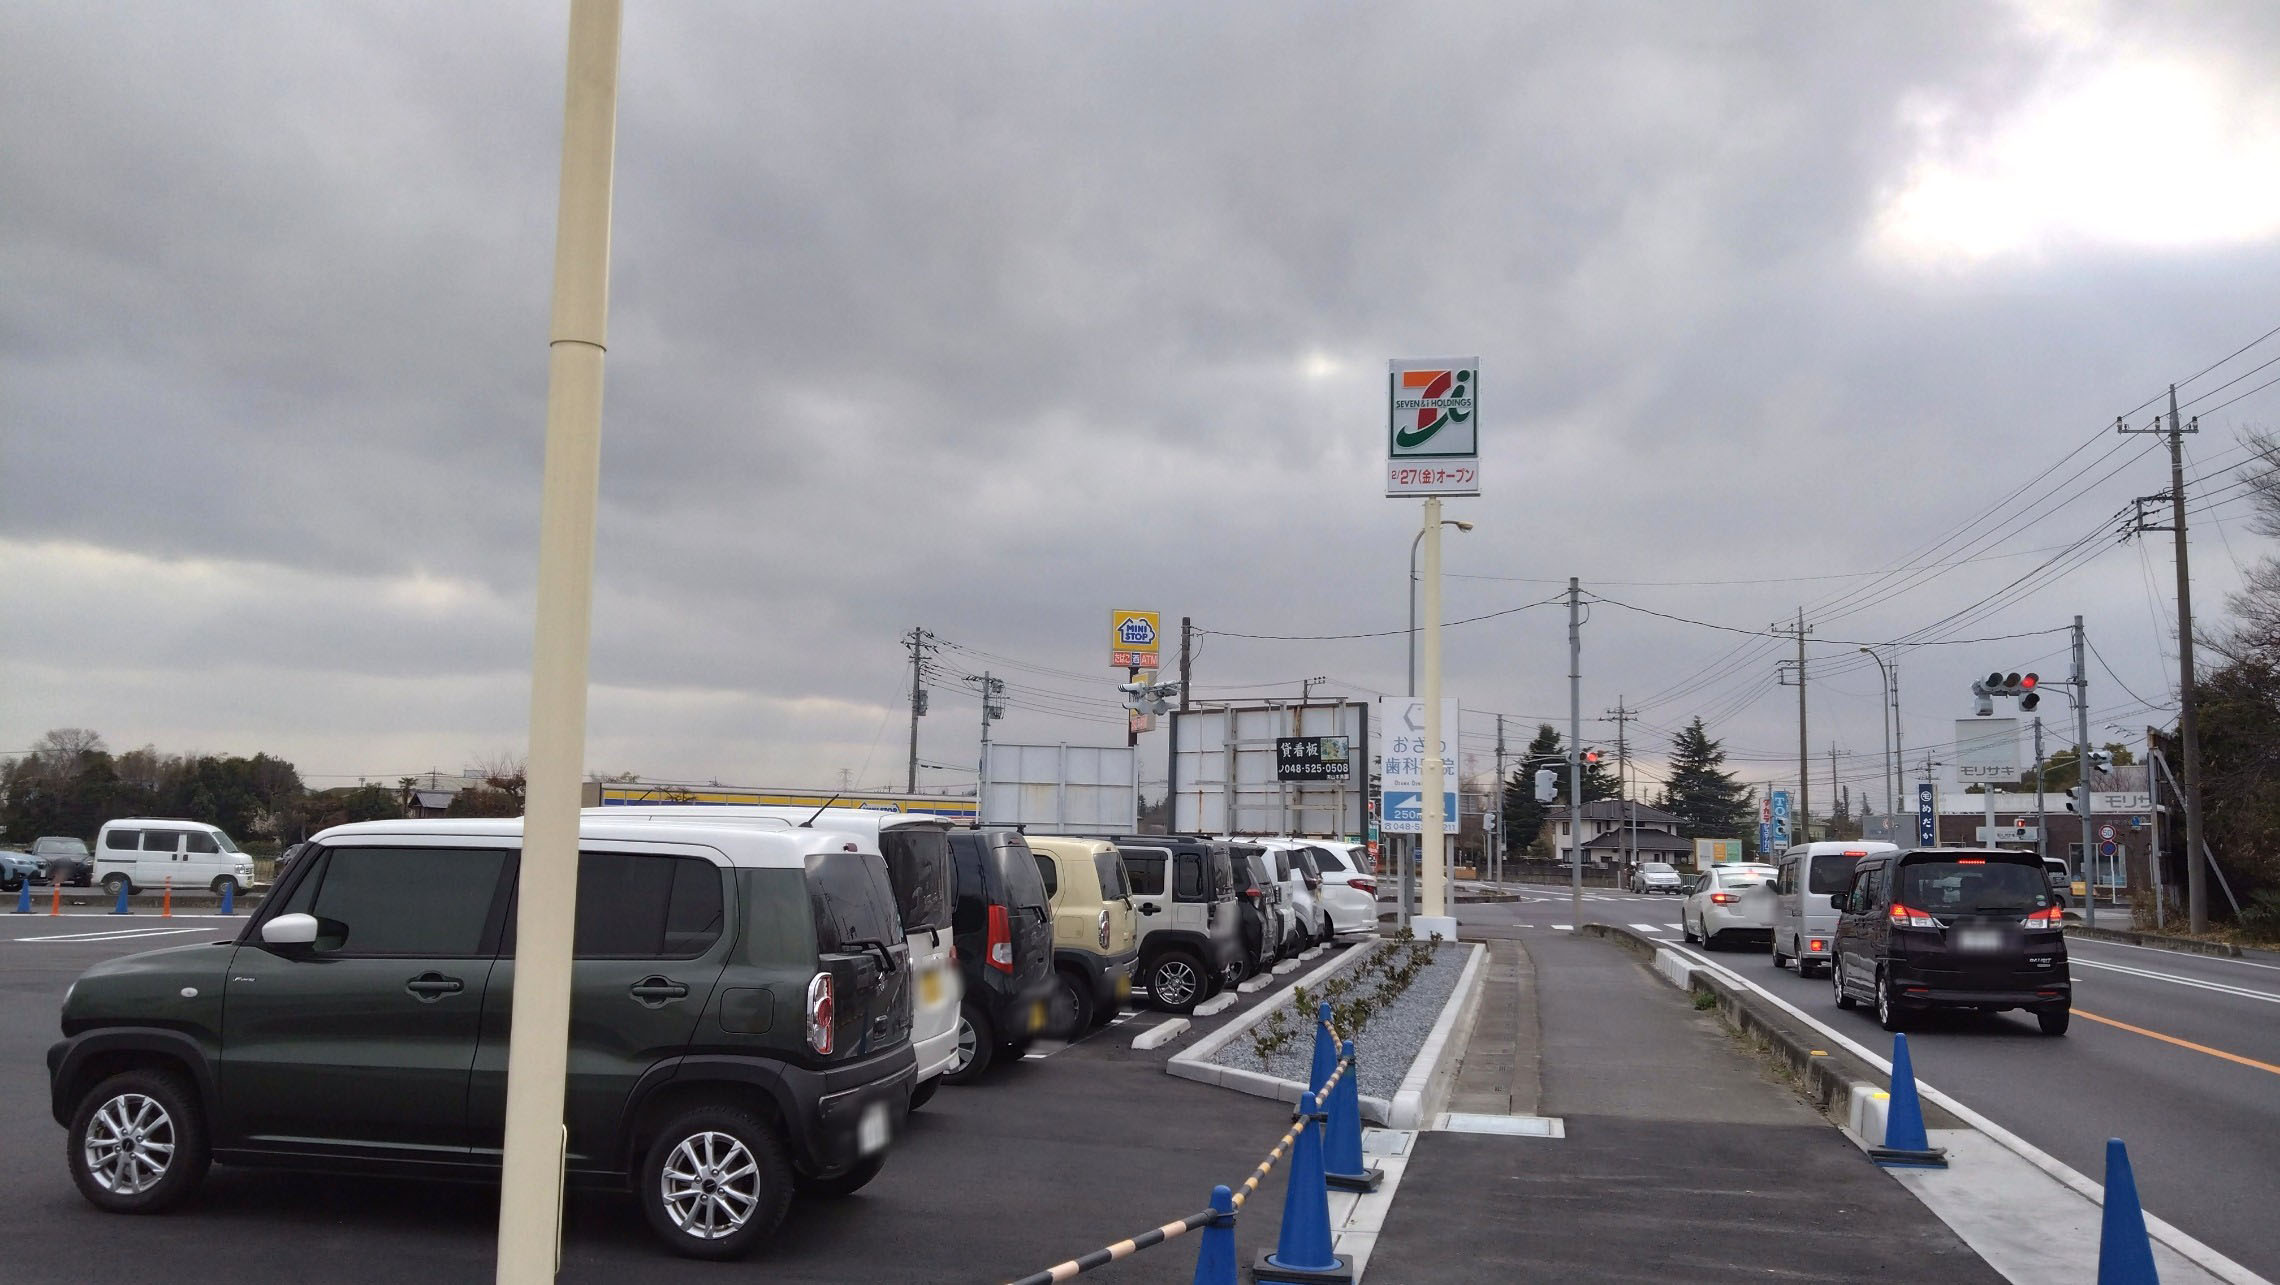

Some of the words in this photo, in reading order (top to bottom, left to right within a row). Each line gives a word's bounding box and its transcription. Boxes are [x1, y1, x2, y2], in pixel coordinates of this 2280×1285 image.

[1430, 398, 1472, 408] HOLDINGS
[1391, 468, 1475, 485] 2/27(金)オープン
[1126, 625, 1147, 633] MINI
[1125, 633, 1148, 641] STOP
[1141, 655, 1157, 665] ATM
[1280, 742, 1319, 758] 貸看板
[1385, 757, 1455, 775] 歯科院
[1960, 766, 2015, 776] モリサキ
[2105, 795, 2153, 808] モリサ
[1922, 804, 1933, 840] めだか
[2103, 829, 2112, 837] 50
